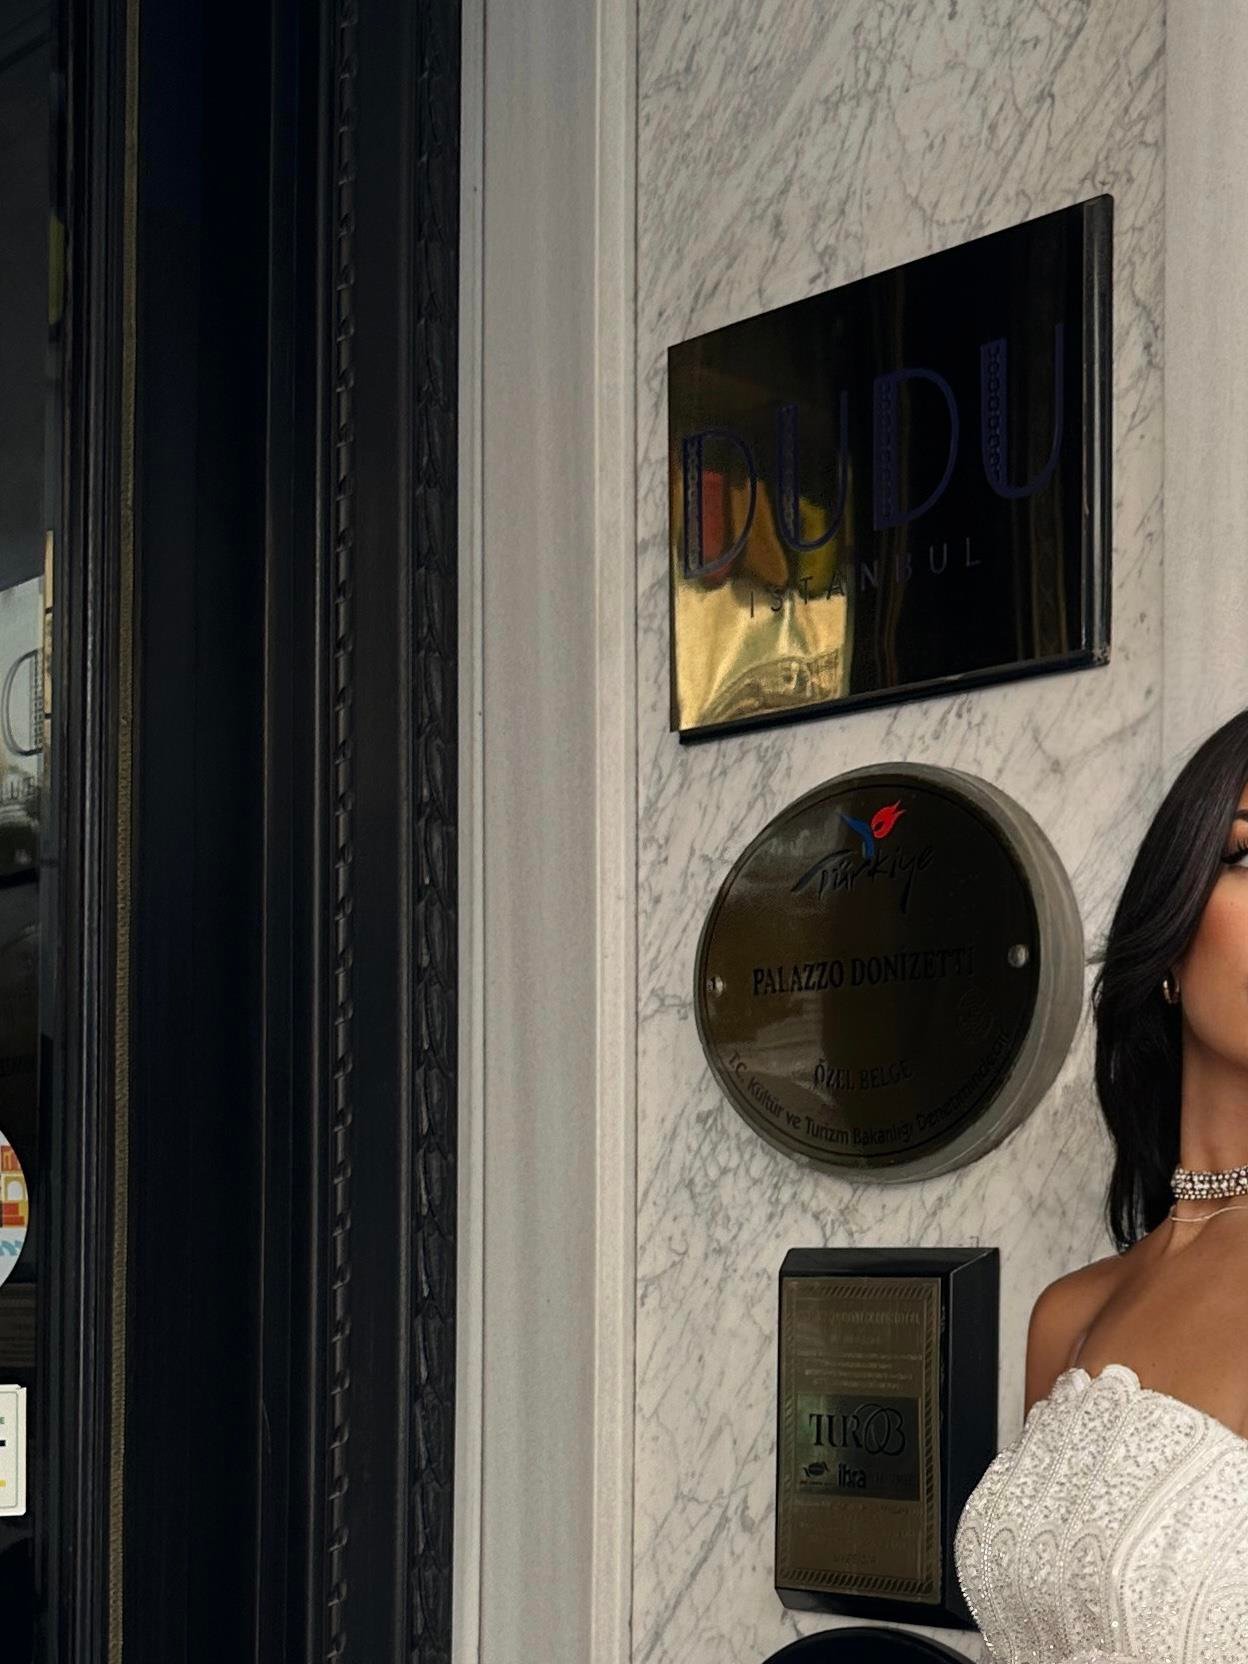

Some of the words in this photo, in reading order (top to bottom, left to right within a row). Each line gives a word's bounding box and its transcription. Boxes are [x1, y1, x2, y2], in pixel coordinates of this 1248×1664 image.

[683, 323, 1064, 580] DUDU
[749, 536, 984, 619] ISTANBUL
[752, 959, 844, 996] PALAZZO
[785, 1111, 802, 1130] ve
